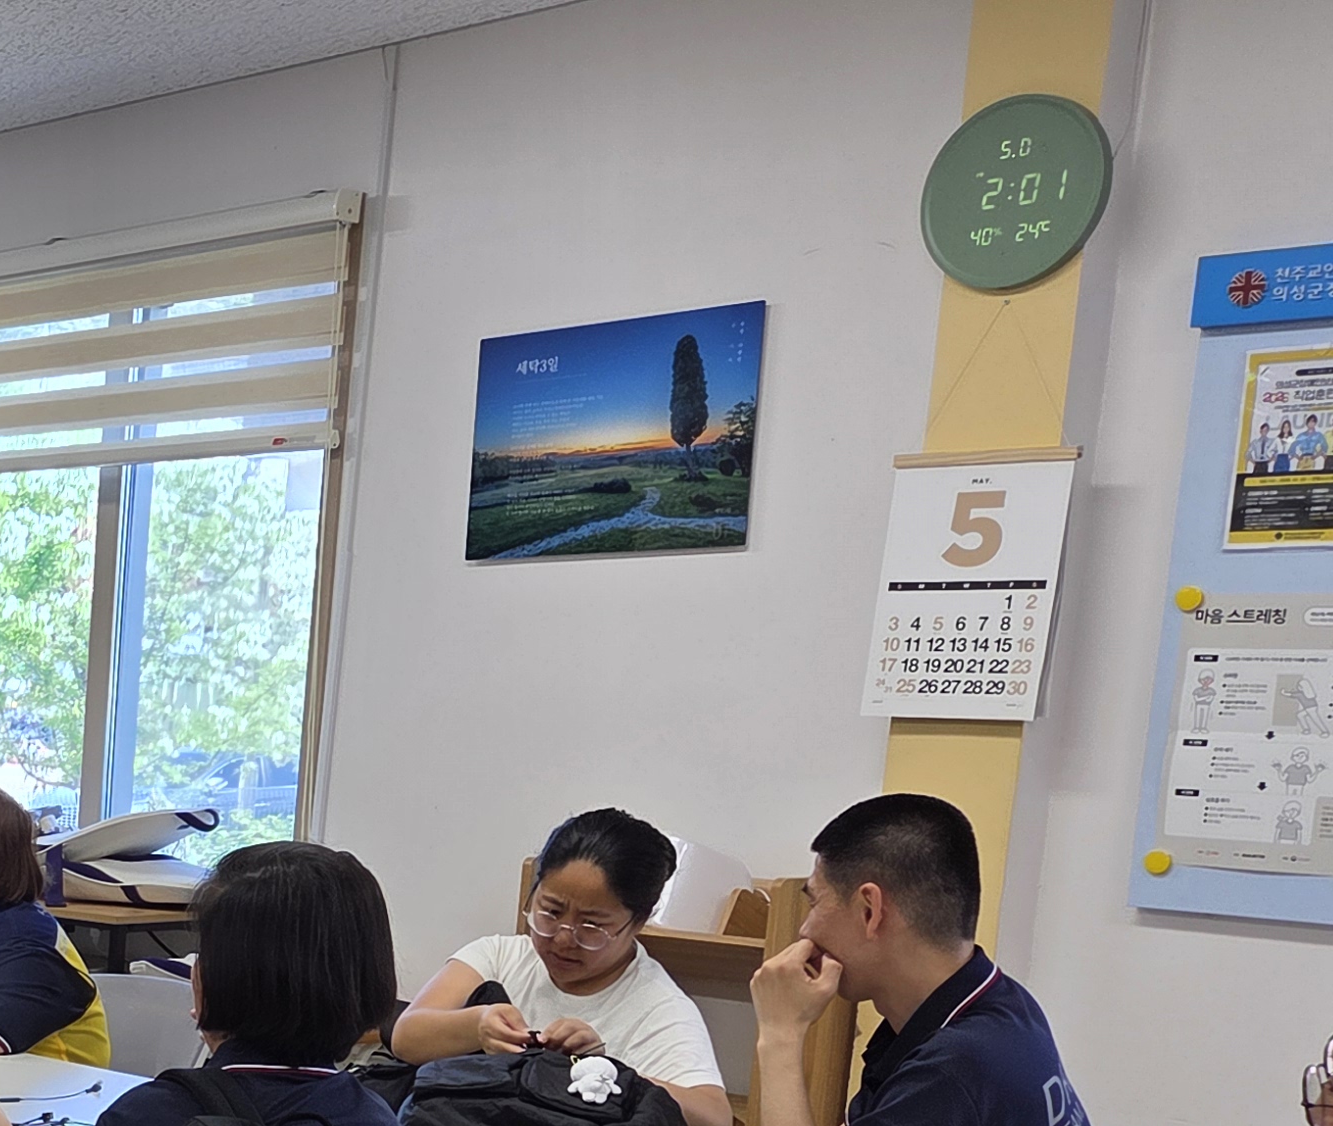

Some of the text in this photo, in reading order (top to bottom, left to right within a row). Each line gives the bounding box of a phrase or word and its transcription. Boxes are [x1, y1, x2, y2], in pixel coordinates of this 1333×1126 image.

[981, 169, 1068, 210] 2:01
[941, 490, 1006, 568] 5
[1004, 594, 1038, 610] 1 2
[888, 616, 1034, 631] 3 4 5 6 7 8 9
[1195, 608, 1224, 625] 마음
[1225, 608, 1288, 625] 스트레칭
[883, 637, 1035, 652] 10 11 12 13 14 15 16
[879, 658, 1031, 674] 17 18 19 20 21 22 23
[895, 678, 916, 693] 25
[918, 679, 938, 694] 26
[940, 680, 961, 694] 27
[963, 680, 983, 694] 28
[984, 680, 1005, 695] 29
[1007, 680, 1028, 695] 30
